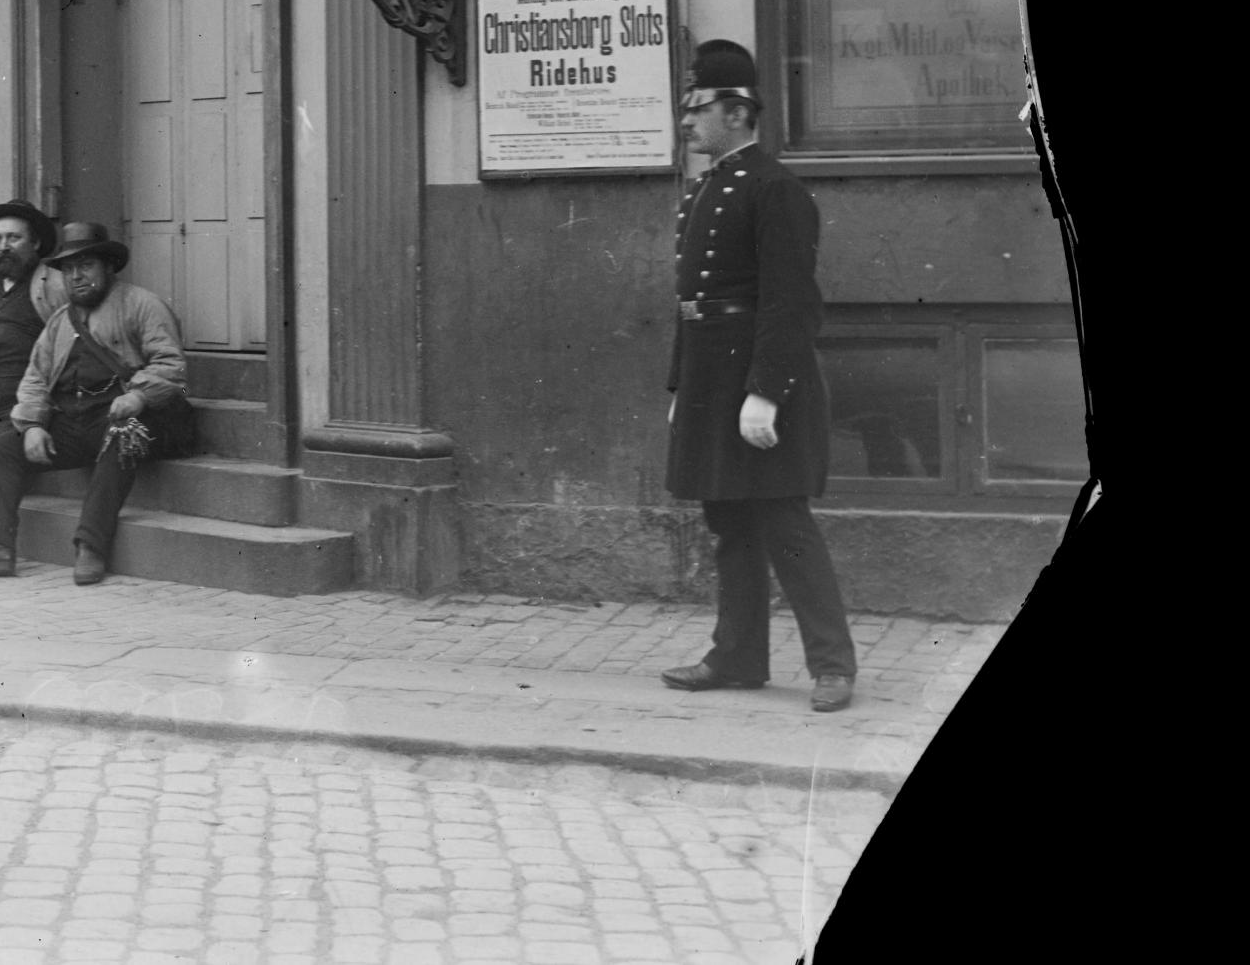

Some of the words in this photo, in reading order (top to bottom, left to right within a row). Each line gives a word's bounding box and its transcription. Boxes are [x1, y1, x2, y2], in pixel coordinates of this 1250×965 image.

[484, 8, 612, 56] Christiansborg
[620, 5, 664, 48] Slots
[530, 57, 617, 87] Ridehus
